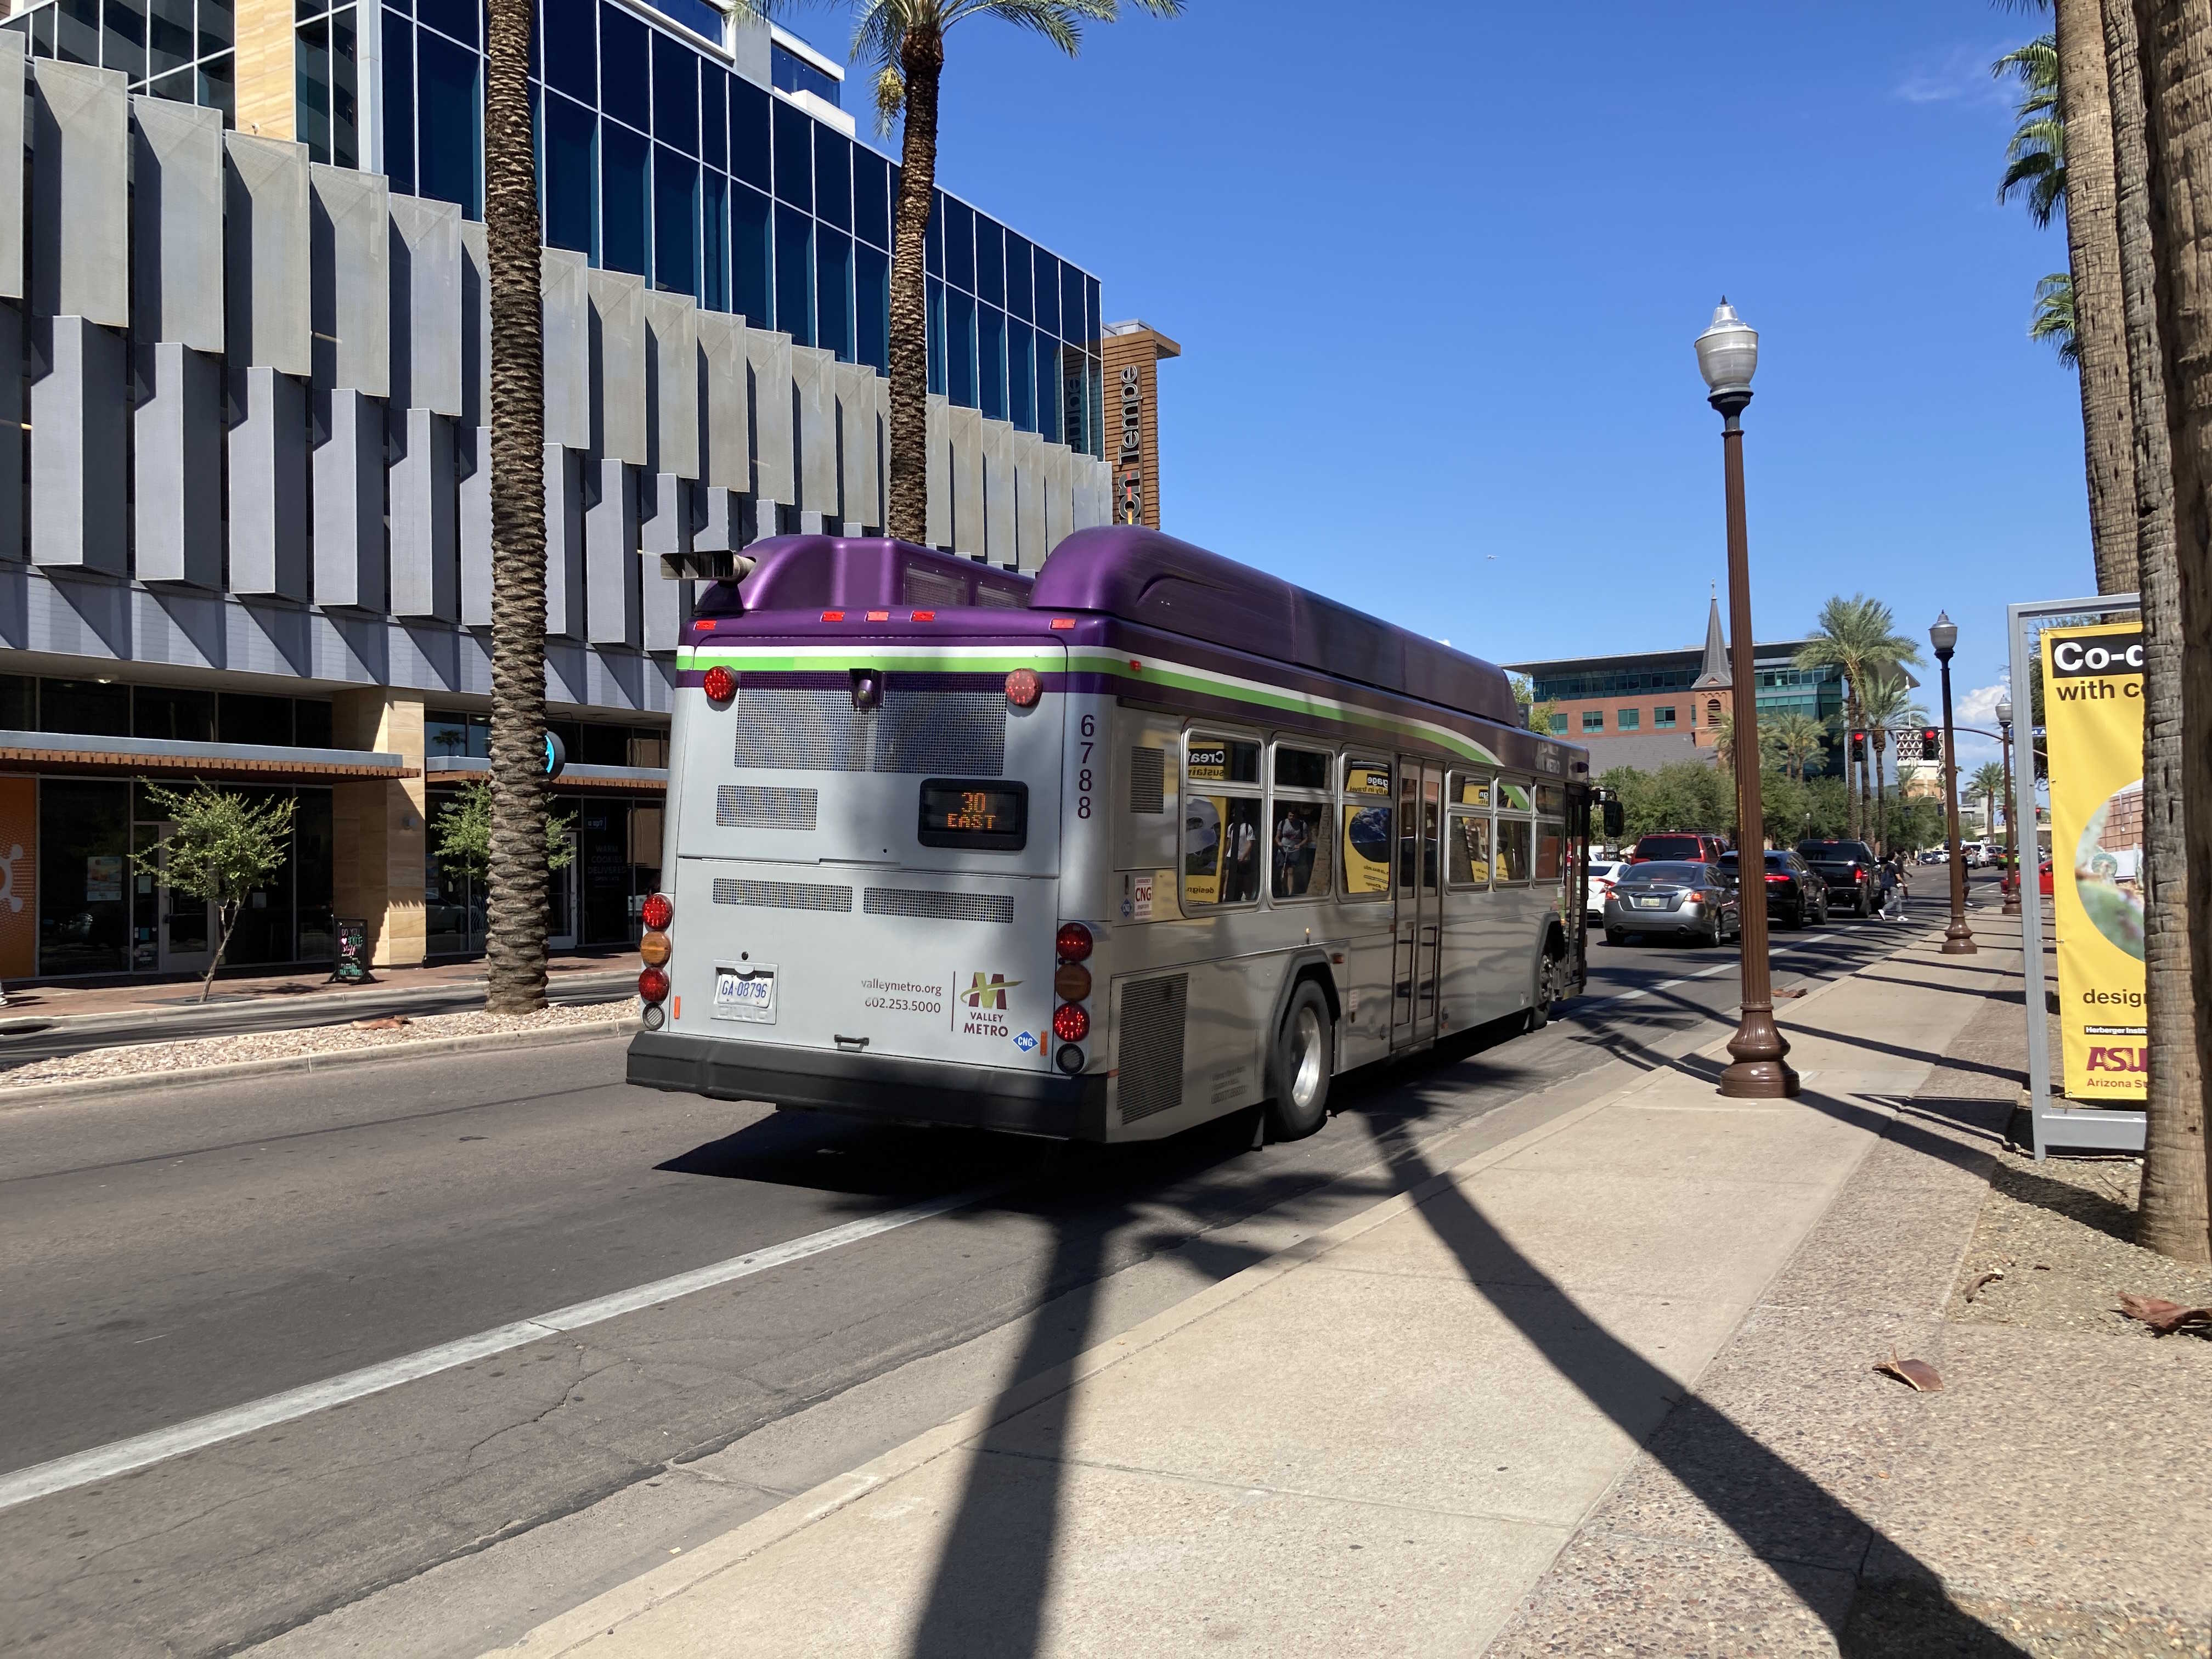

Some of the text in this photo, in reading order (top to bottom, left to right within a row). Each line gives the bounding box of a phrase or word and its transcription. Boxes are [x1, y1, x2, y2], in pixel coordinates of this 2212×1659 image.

[1117, 365, 1143, 465] Tempe
[2056, 679, 2144, 701] with c
[1077, 714, 1096, 820] 6788
[961, 792, 987, 813] 30
[947, 814, 997, 829] EAST
[1135, 887, 1151, 902] CNG
[861, 978, 943, 996] valleymetro.org
[865, 997, 941, 1013] 602.253.5000
[970, 1011, 1004, 1023] VALLEY
[963, 1023, 1009, 1037] METRO
[2086, 1026, 2126, 1035] Herberger
[1017, 1036, 1034, 1047] CNG
[2086, 1046, 2148, 1073] ASU
[2086, 1078, 2131, 1088] Arizona
